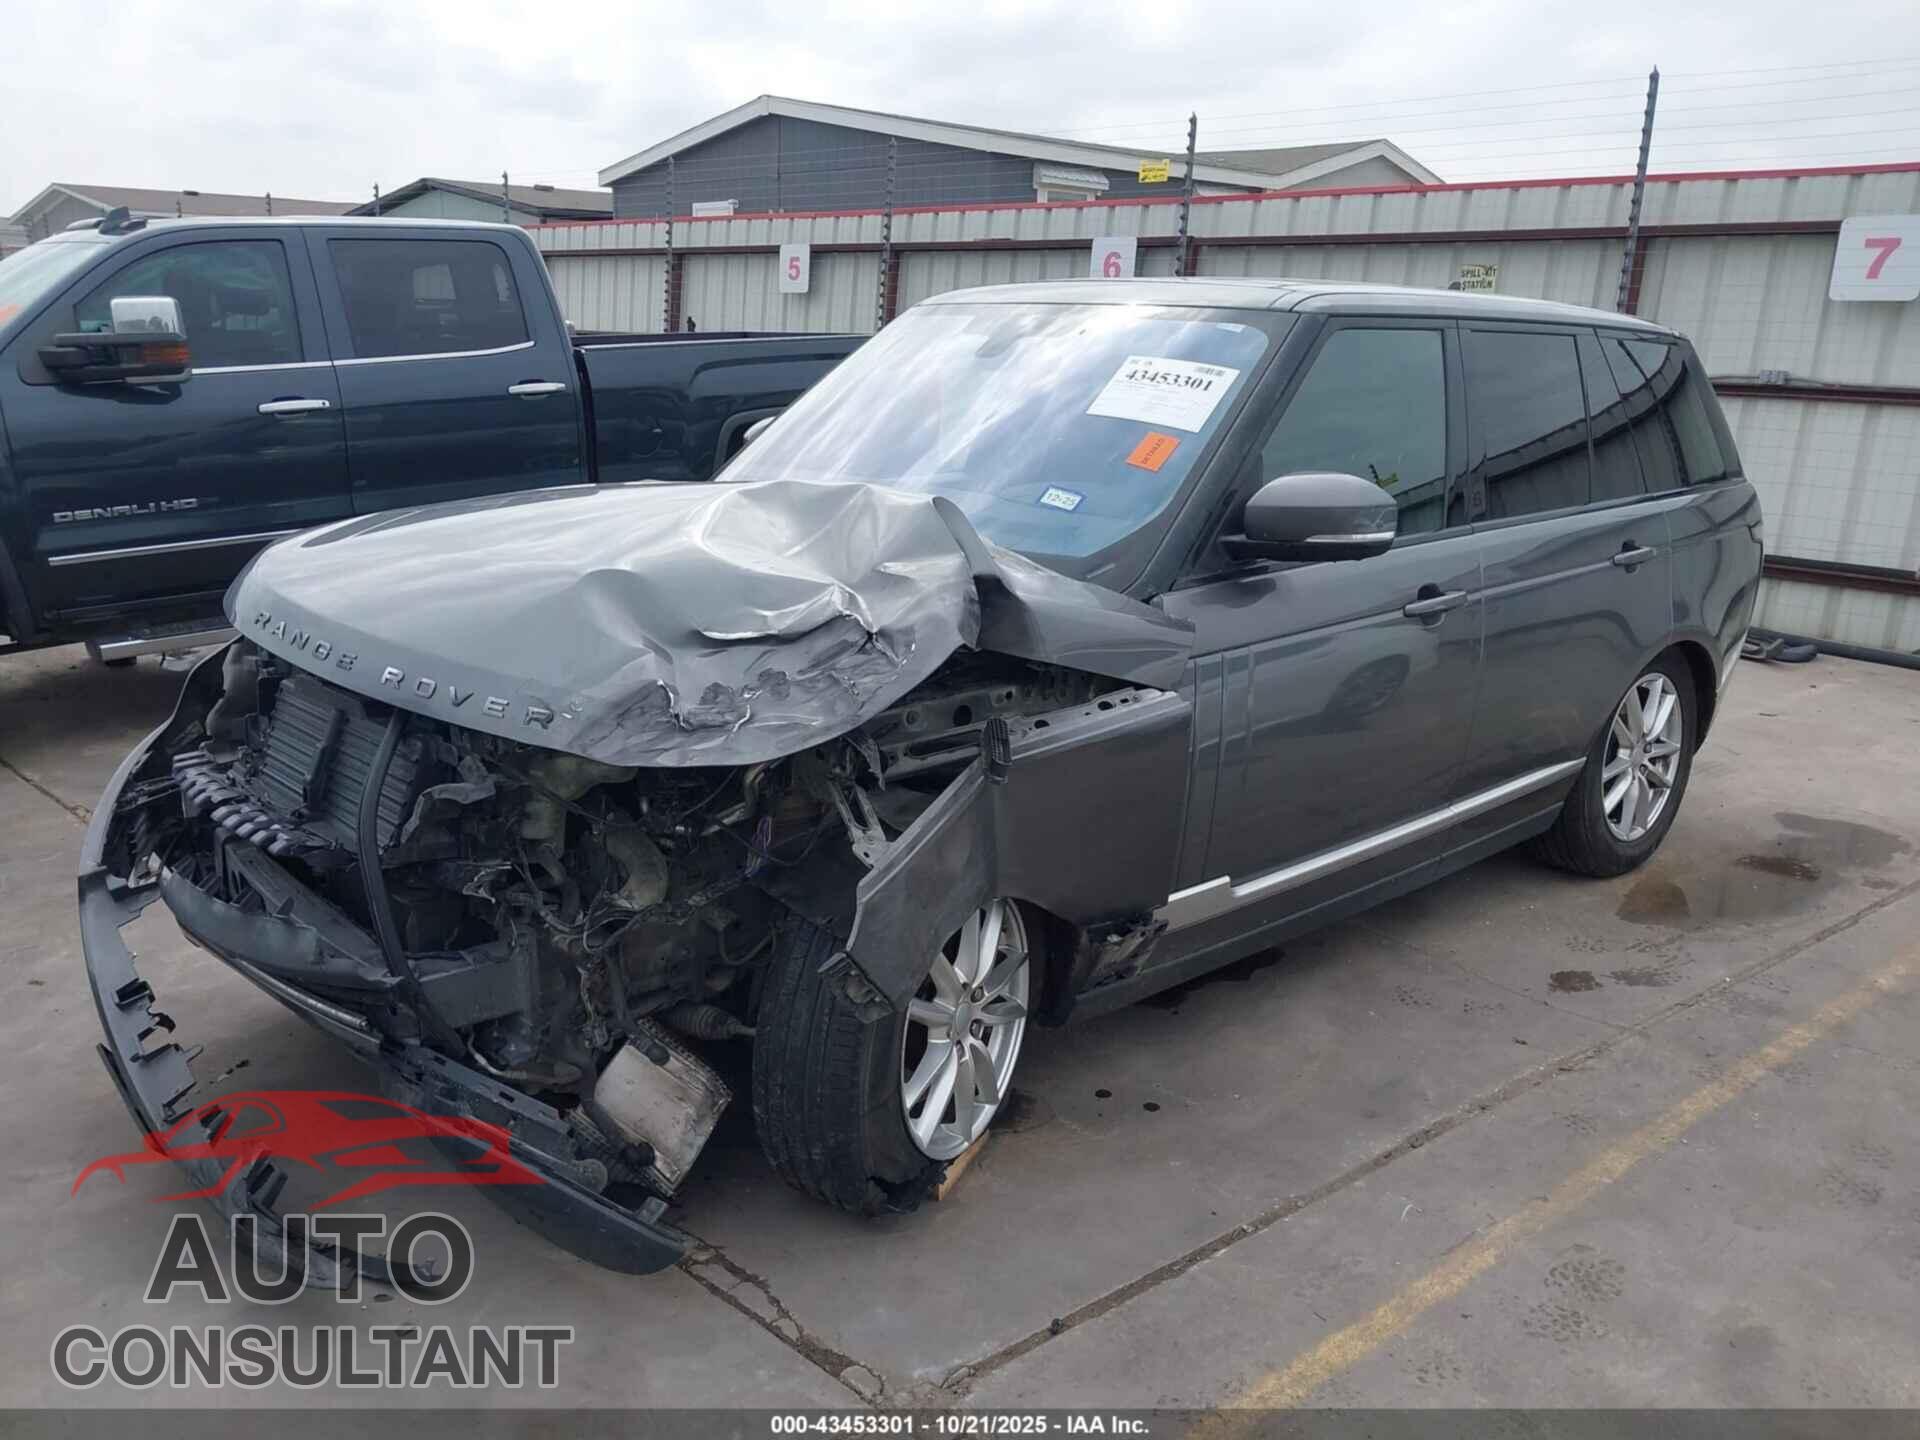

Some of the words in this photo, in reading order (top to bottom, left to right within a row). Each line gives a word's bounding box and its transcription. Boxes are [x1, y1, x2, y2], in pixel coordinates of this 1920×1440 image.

[787, 256, 801, 281] 5
[1103, 251, 1122, 278] 6
[1864, 237, 1903, 280] 7
[1125, 369, 1214, 392] 43453301
[52, 502, 156, 523] DENALI
[160, 497, 199, 512] HD
[253, 611, 358, 671] RANGE
[380, 665, 556, 730] ROVER
